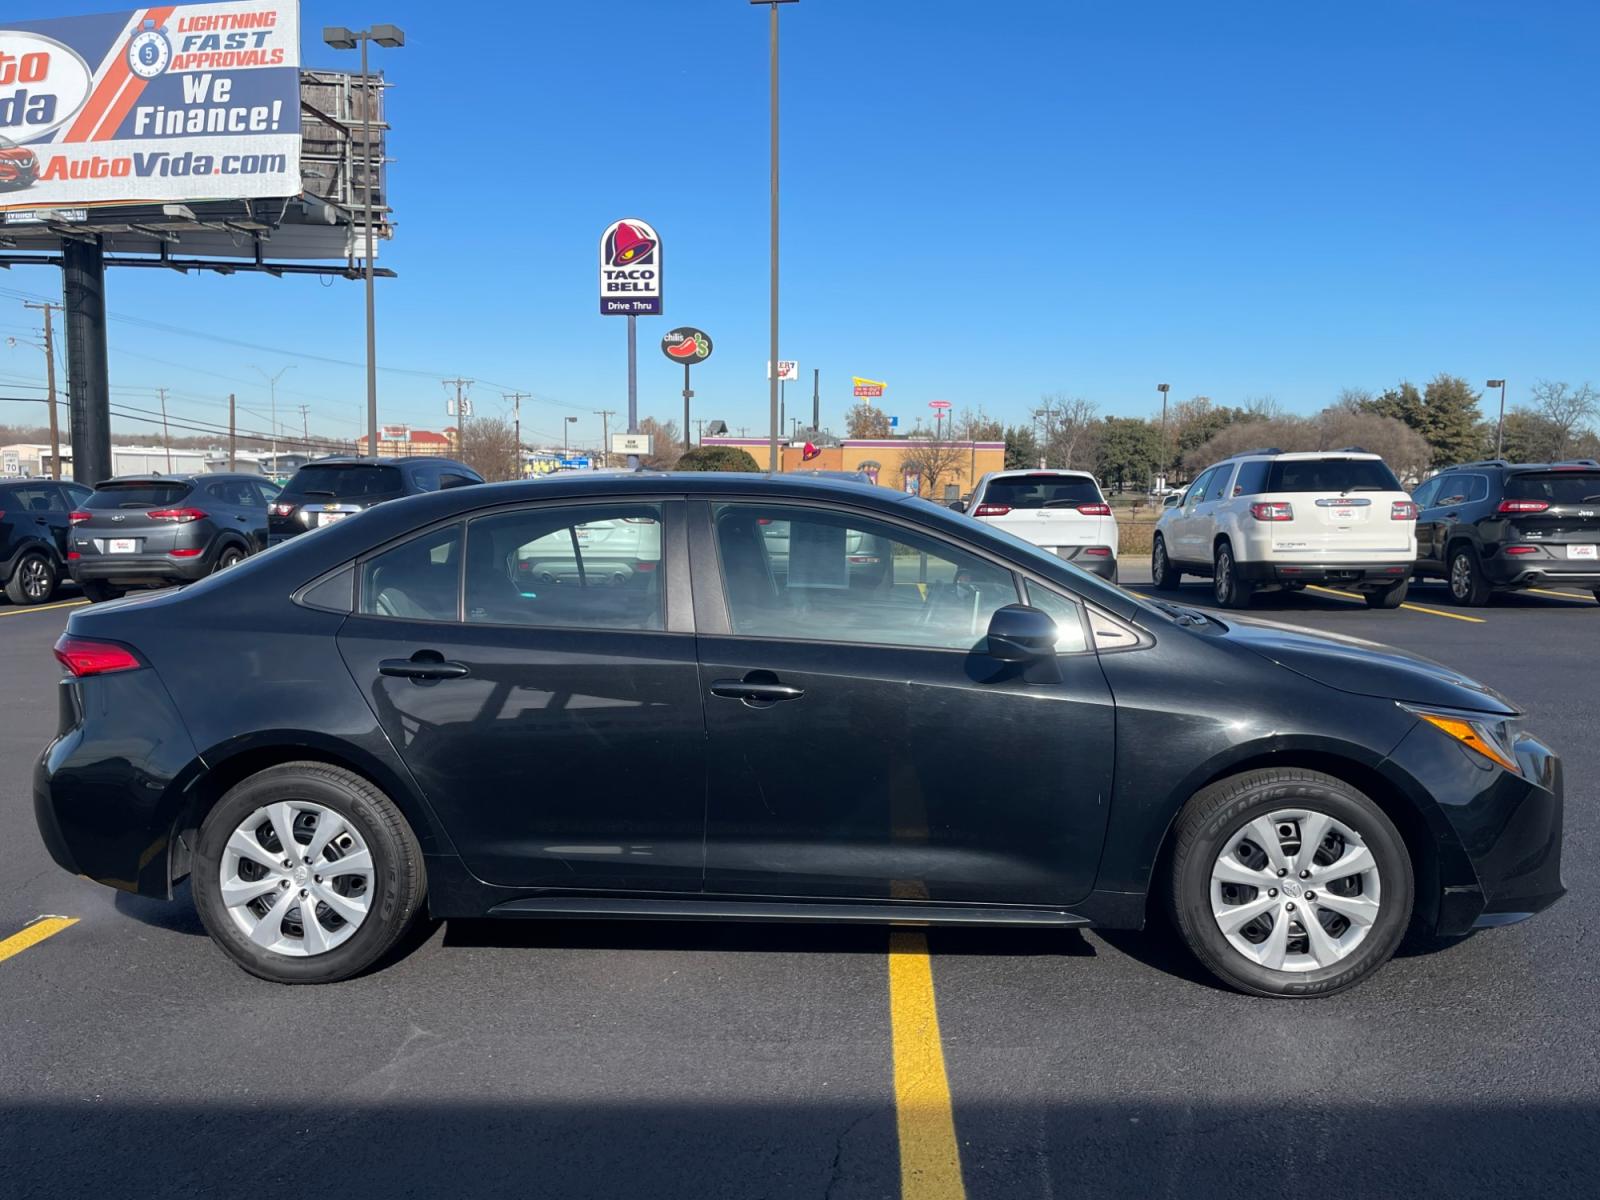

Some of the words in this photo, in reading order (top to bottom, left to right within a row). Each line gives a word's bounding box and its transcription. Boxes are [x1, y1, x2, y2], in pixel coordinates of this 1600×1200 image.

[178, 11, 276, 33] LIGHTNING
[181, 30, 273, 52] FAST
[145, 47, 153, 60] 5
[170, 49, 284, 70] APPROVALS
[182, 73, 232, 104] We
[134, 100, 283, 135] Finance!
[39, 151, 287, 181] AutoVida.com
[603, 269, 655, 281] TACO
[606, 281, 656, 292] BELL
[608, 301, 630, 310] Drive
[633, 301, 652, 310] Thru
[1578, 509, 1594, 517] Jeep
